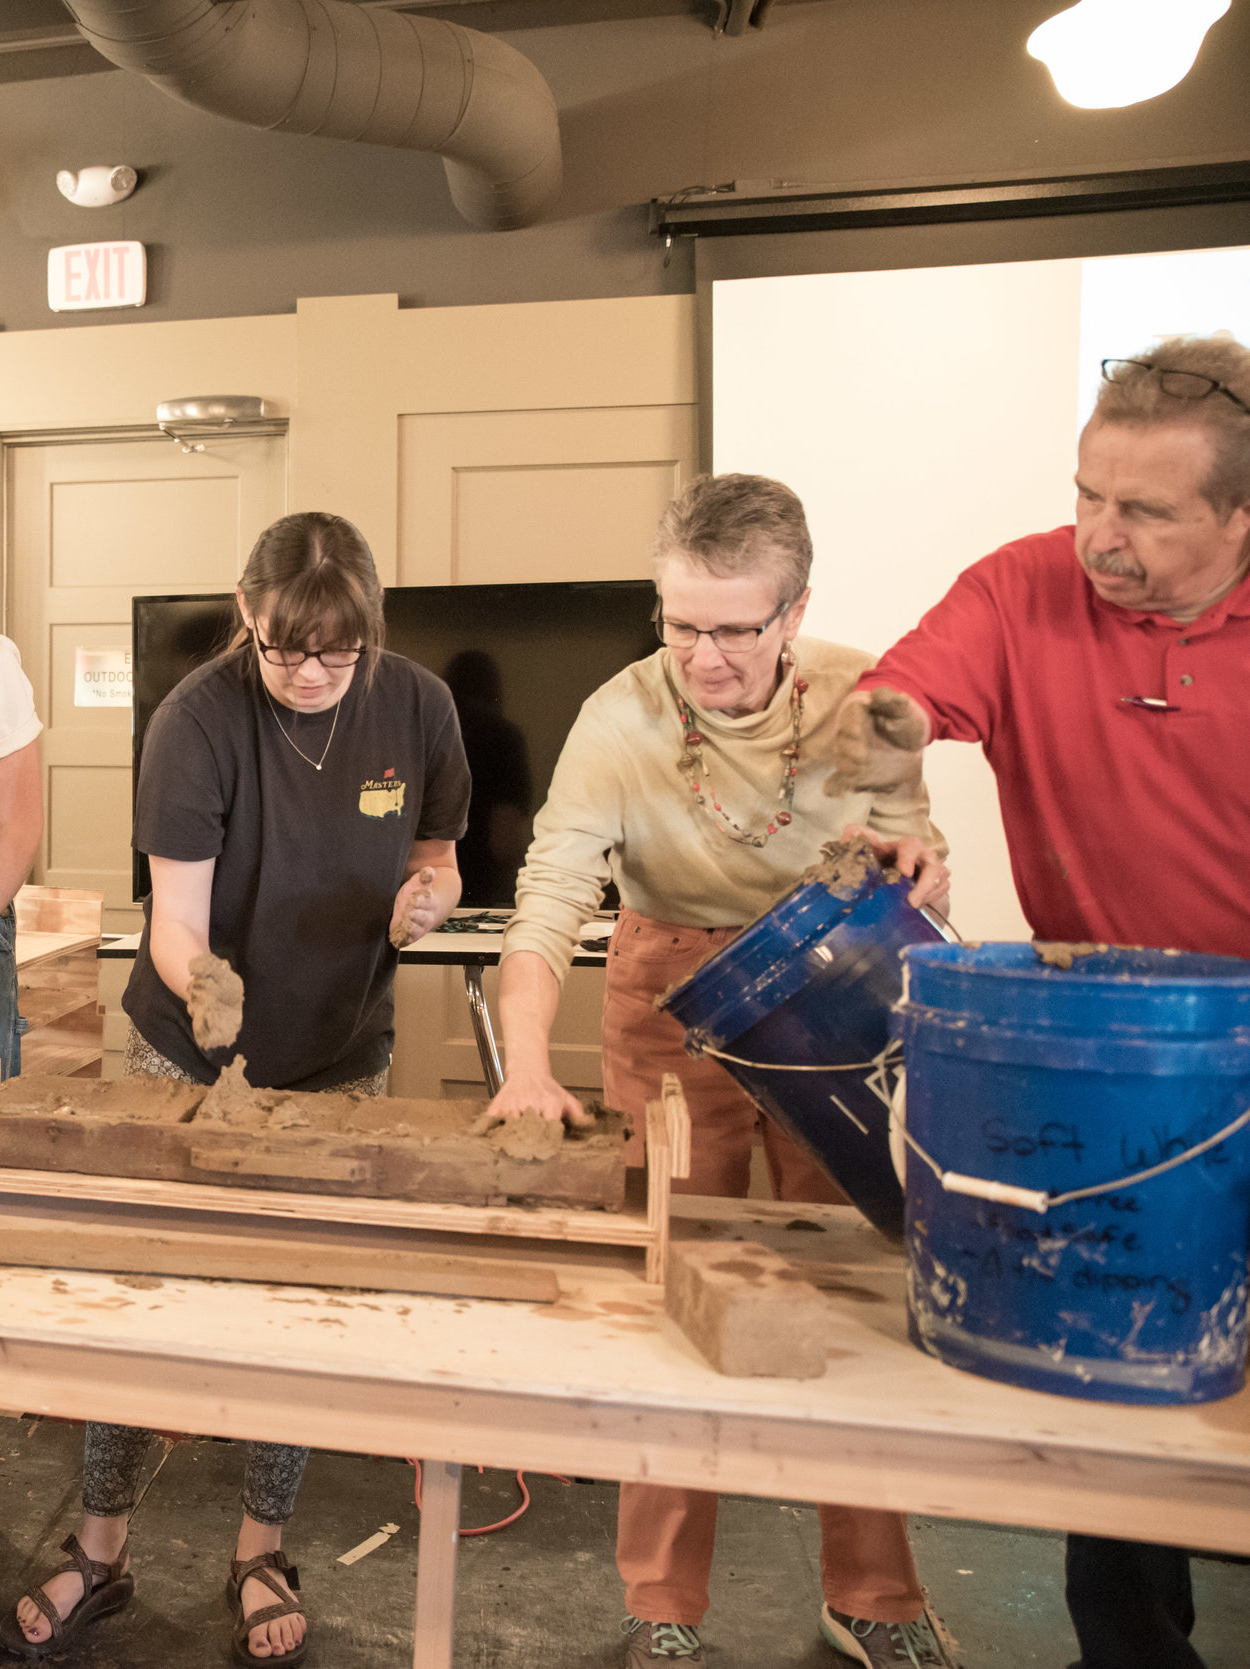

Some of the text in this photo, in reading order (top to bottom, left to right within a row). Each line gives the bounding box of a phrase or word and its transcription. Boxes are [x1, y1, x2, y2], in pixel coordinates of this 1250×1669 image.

[64, 246, 130, 302] EXIT
[84, 671, 133, 683] OUTDOO
[981, 1117, 1085, 1164] Soft
[1119, 1121, 1233, 1170] Whte
